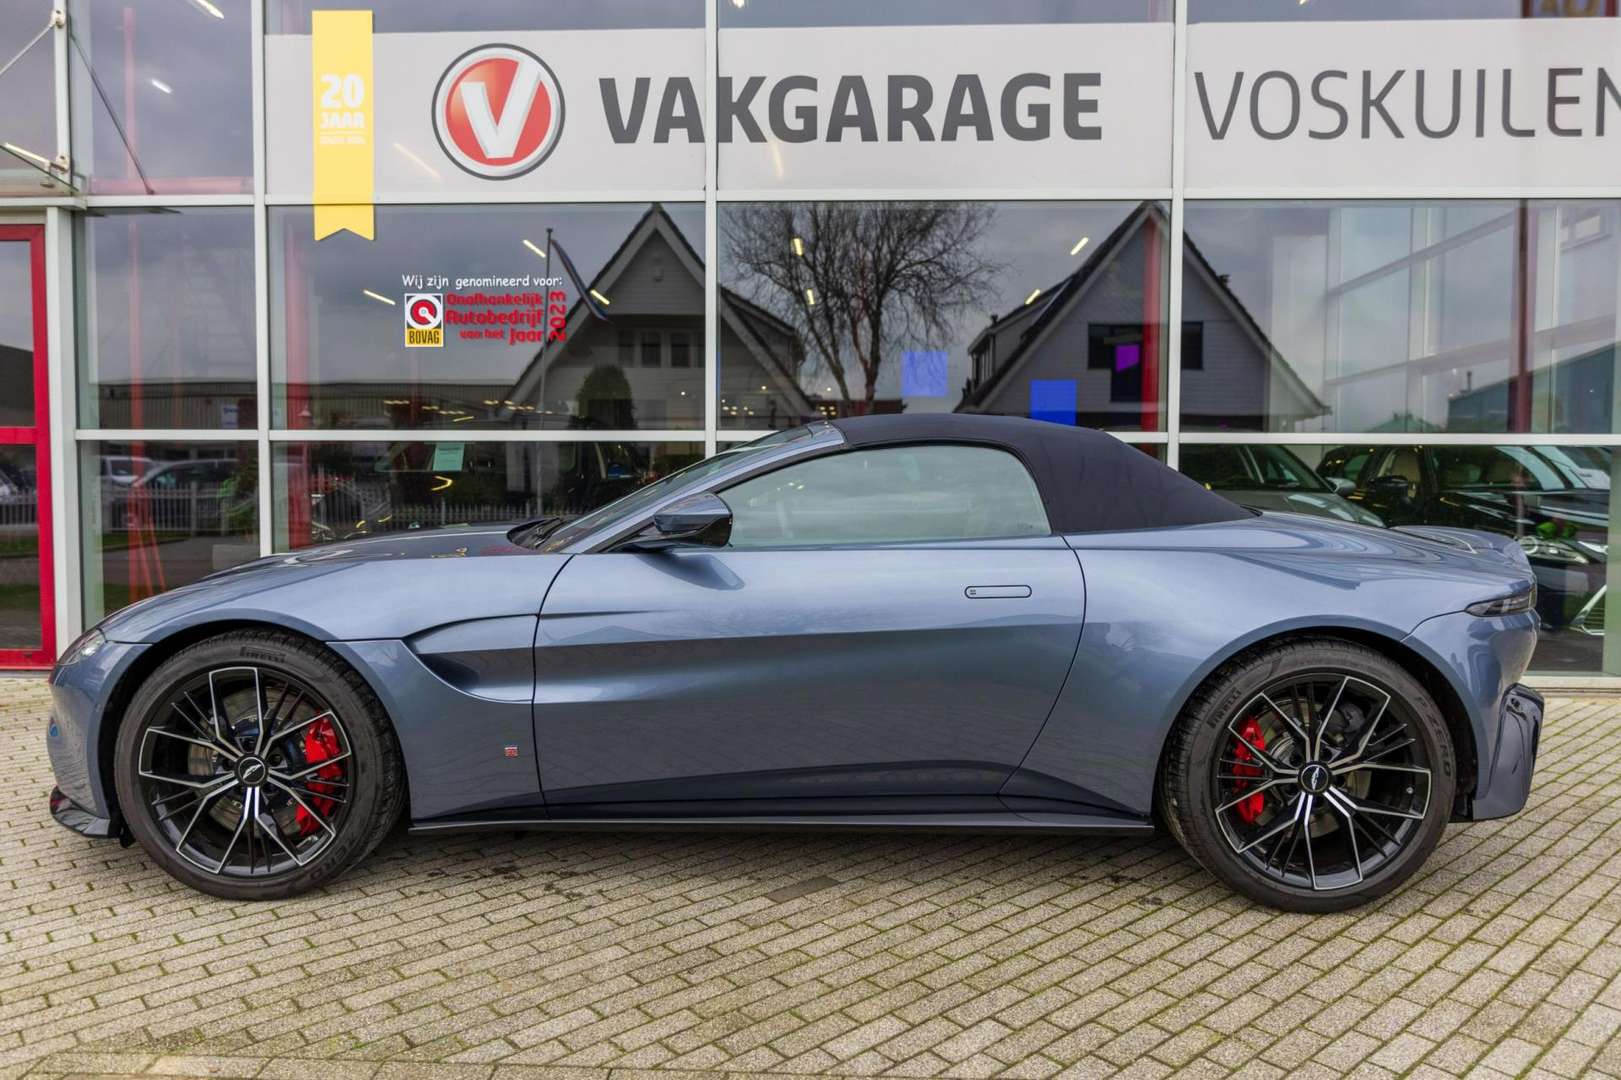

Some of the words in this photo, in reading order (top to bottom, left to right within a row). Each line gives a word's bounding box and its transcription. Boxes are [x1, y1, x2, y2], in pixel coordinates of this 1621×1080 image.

[320, 74, 365, 108] 20
[598, 72, 1102, 144] VAKGARAGE
[402, 274, 423, 290] Wij
[427, 275, 449, 290] zijn
[455, 275, 530, 290] genomineerd
[533, 276, 563, 287] voor:
[445, 309, 544, 327] Autobedrijf
[550, 291, 567, 342] 2023
[409, 330, 440, 345] BOVAG
